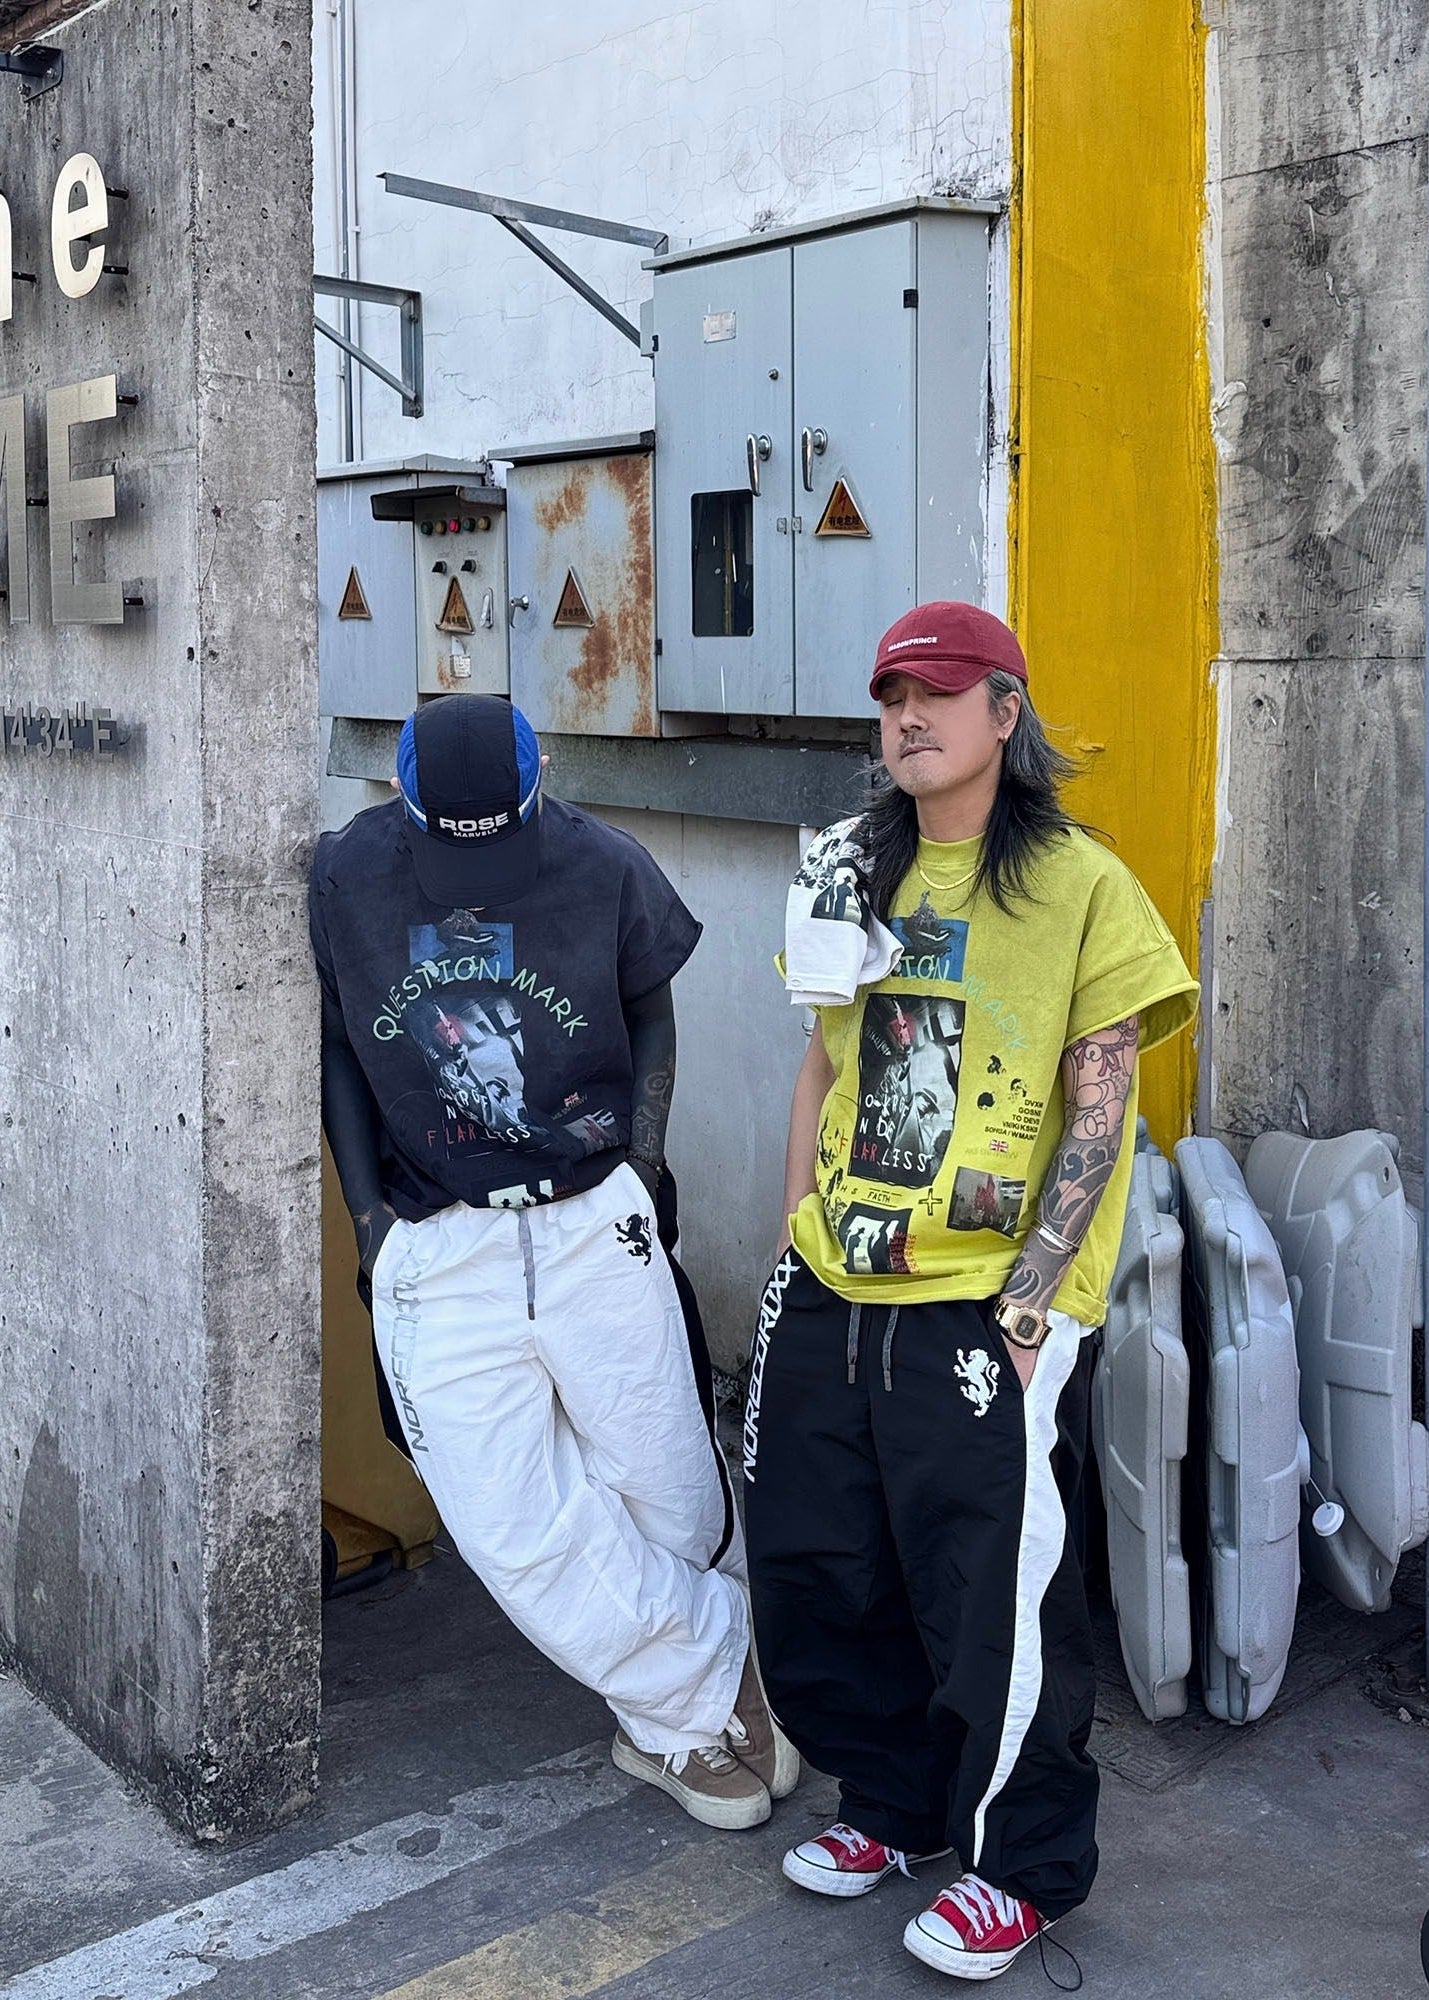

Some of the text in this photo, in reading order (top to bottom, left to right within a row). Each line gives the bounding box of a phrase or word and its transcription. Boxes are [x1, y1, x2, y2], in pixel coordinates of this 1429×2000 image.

[439, 812, 509, 832] ROSE
[372, 955, 589, 1041] QUESTION MARK
[958, 974, 1031, 1056] MARK
[1012, 1114, 1022, 1122] TO
